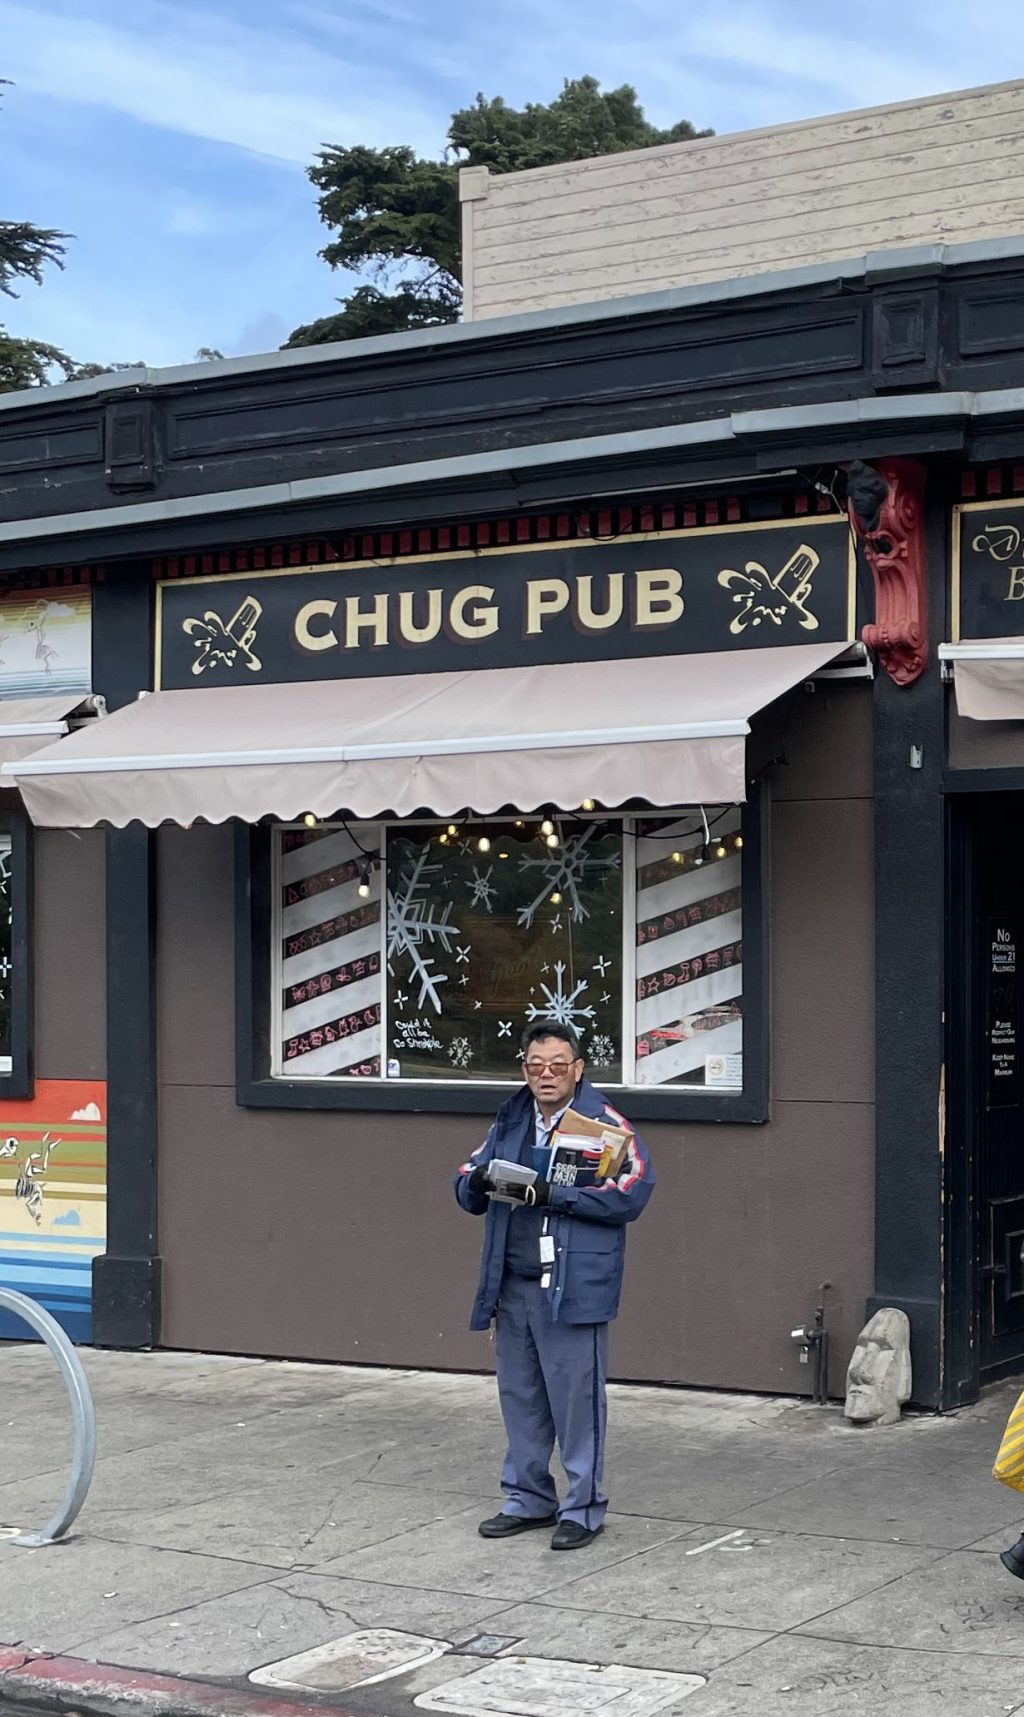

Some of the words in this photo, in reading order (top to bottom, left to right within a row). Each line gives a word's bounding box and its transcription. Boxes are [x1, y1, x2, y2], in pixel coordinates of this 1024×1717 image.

[294, 584, 499, 651] CHUG
[526, 568, 684, 635] PUB
[1007, 951, 1016, 961] 21
